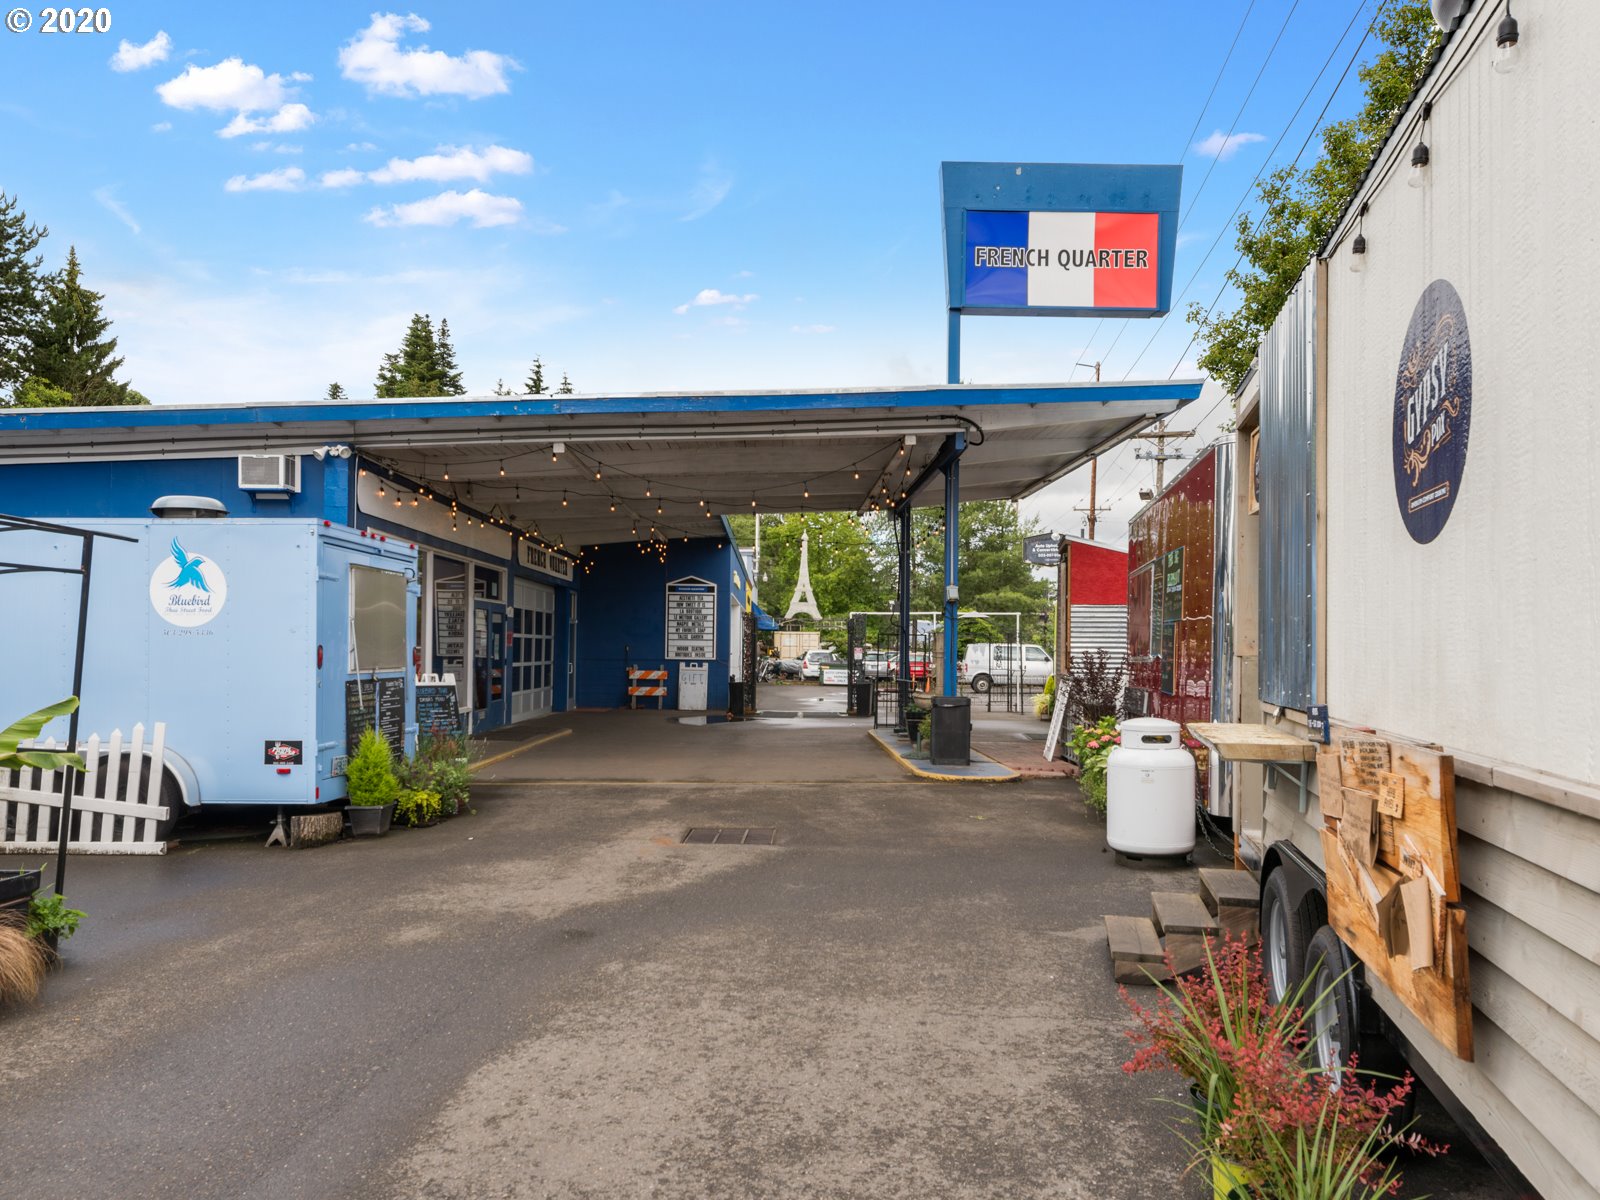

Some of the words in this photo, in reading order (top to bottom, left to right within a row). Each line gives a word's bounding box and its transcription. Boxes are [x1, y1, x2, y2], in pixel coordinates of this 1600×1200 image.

[974, 246, 1049, 267] FRENCH
[1057, 248, 1149, 271] QUARTER
[1407, 341, 1448, 446] GYPSY
[527, 546, 546, 569] FRENCH
[550, 555, 568, 576] QUARTER
[168, 594, 210, 606] Bluebird
[681, 673, 705, 682] GIFT
